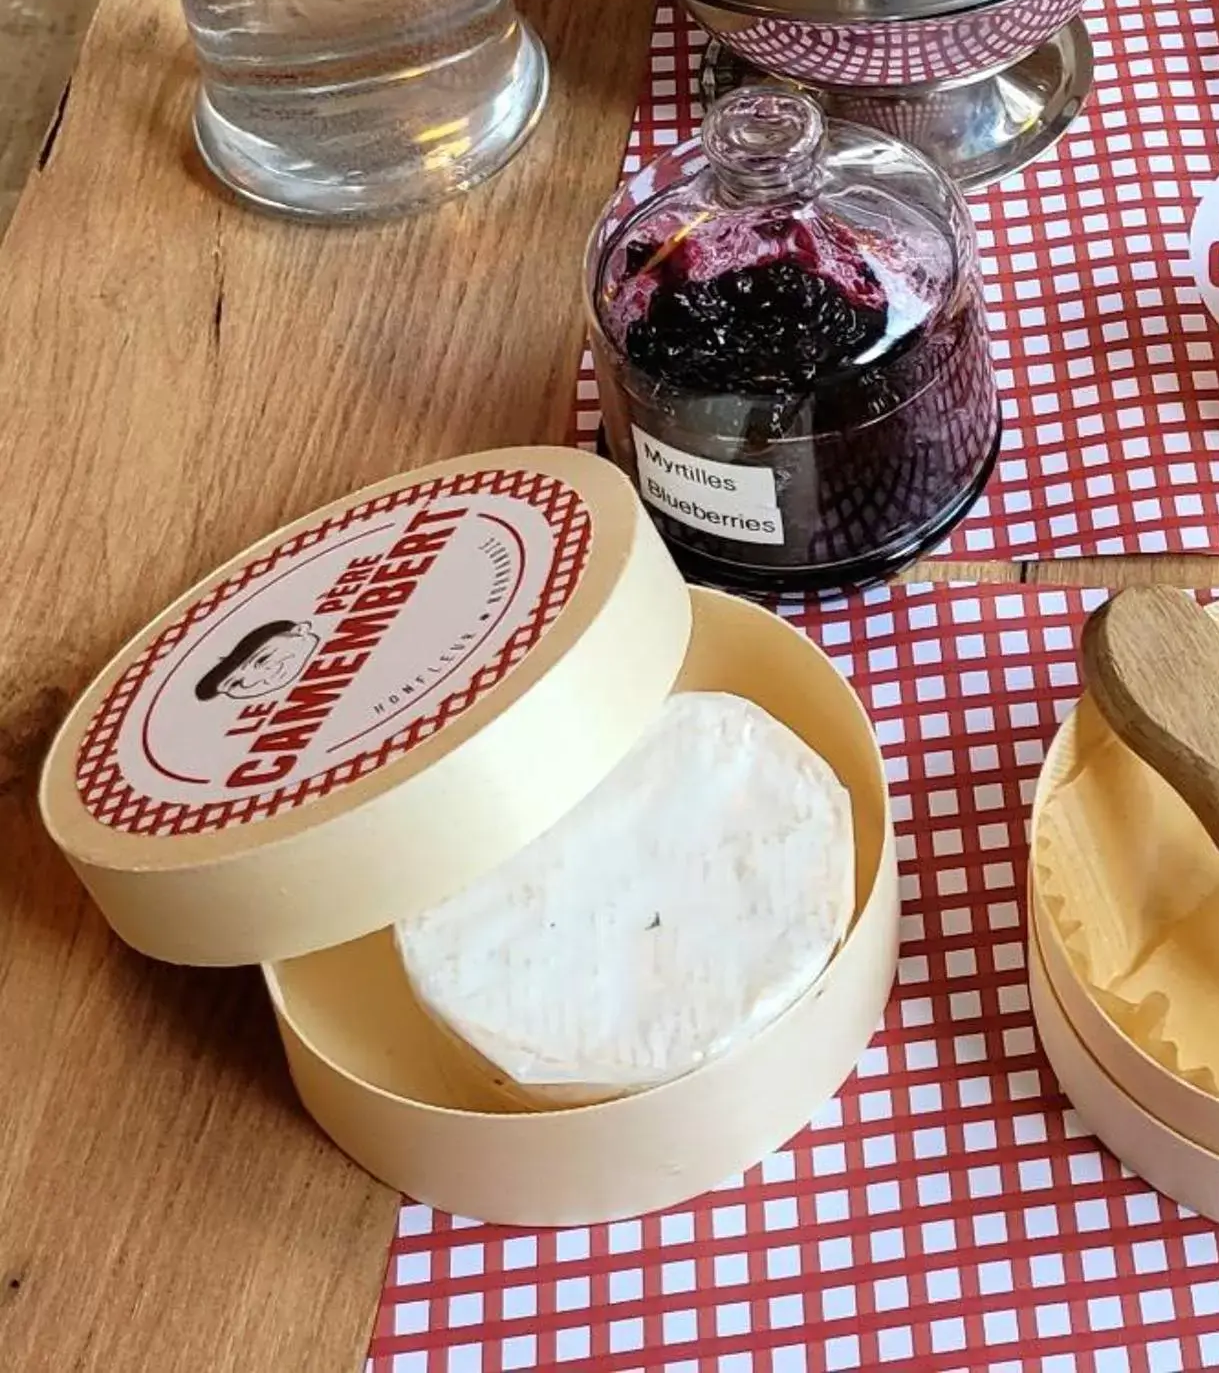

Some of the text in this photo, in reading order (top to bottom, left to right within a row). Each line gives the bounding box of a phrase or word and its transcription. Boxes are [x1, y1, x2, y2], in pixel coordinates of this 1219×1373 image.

[643, 443, 737, 492] Myrtilles
[646, 476, 776, 534] Blueberries
[224, 552, 384, 738] LE PÈRE
[225, 507, 469, 789] CAMEMBERT
